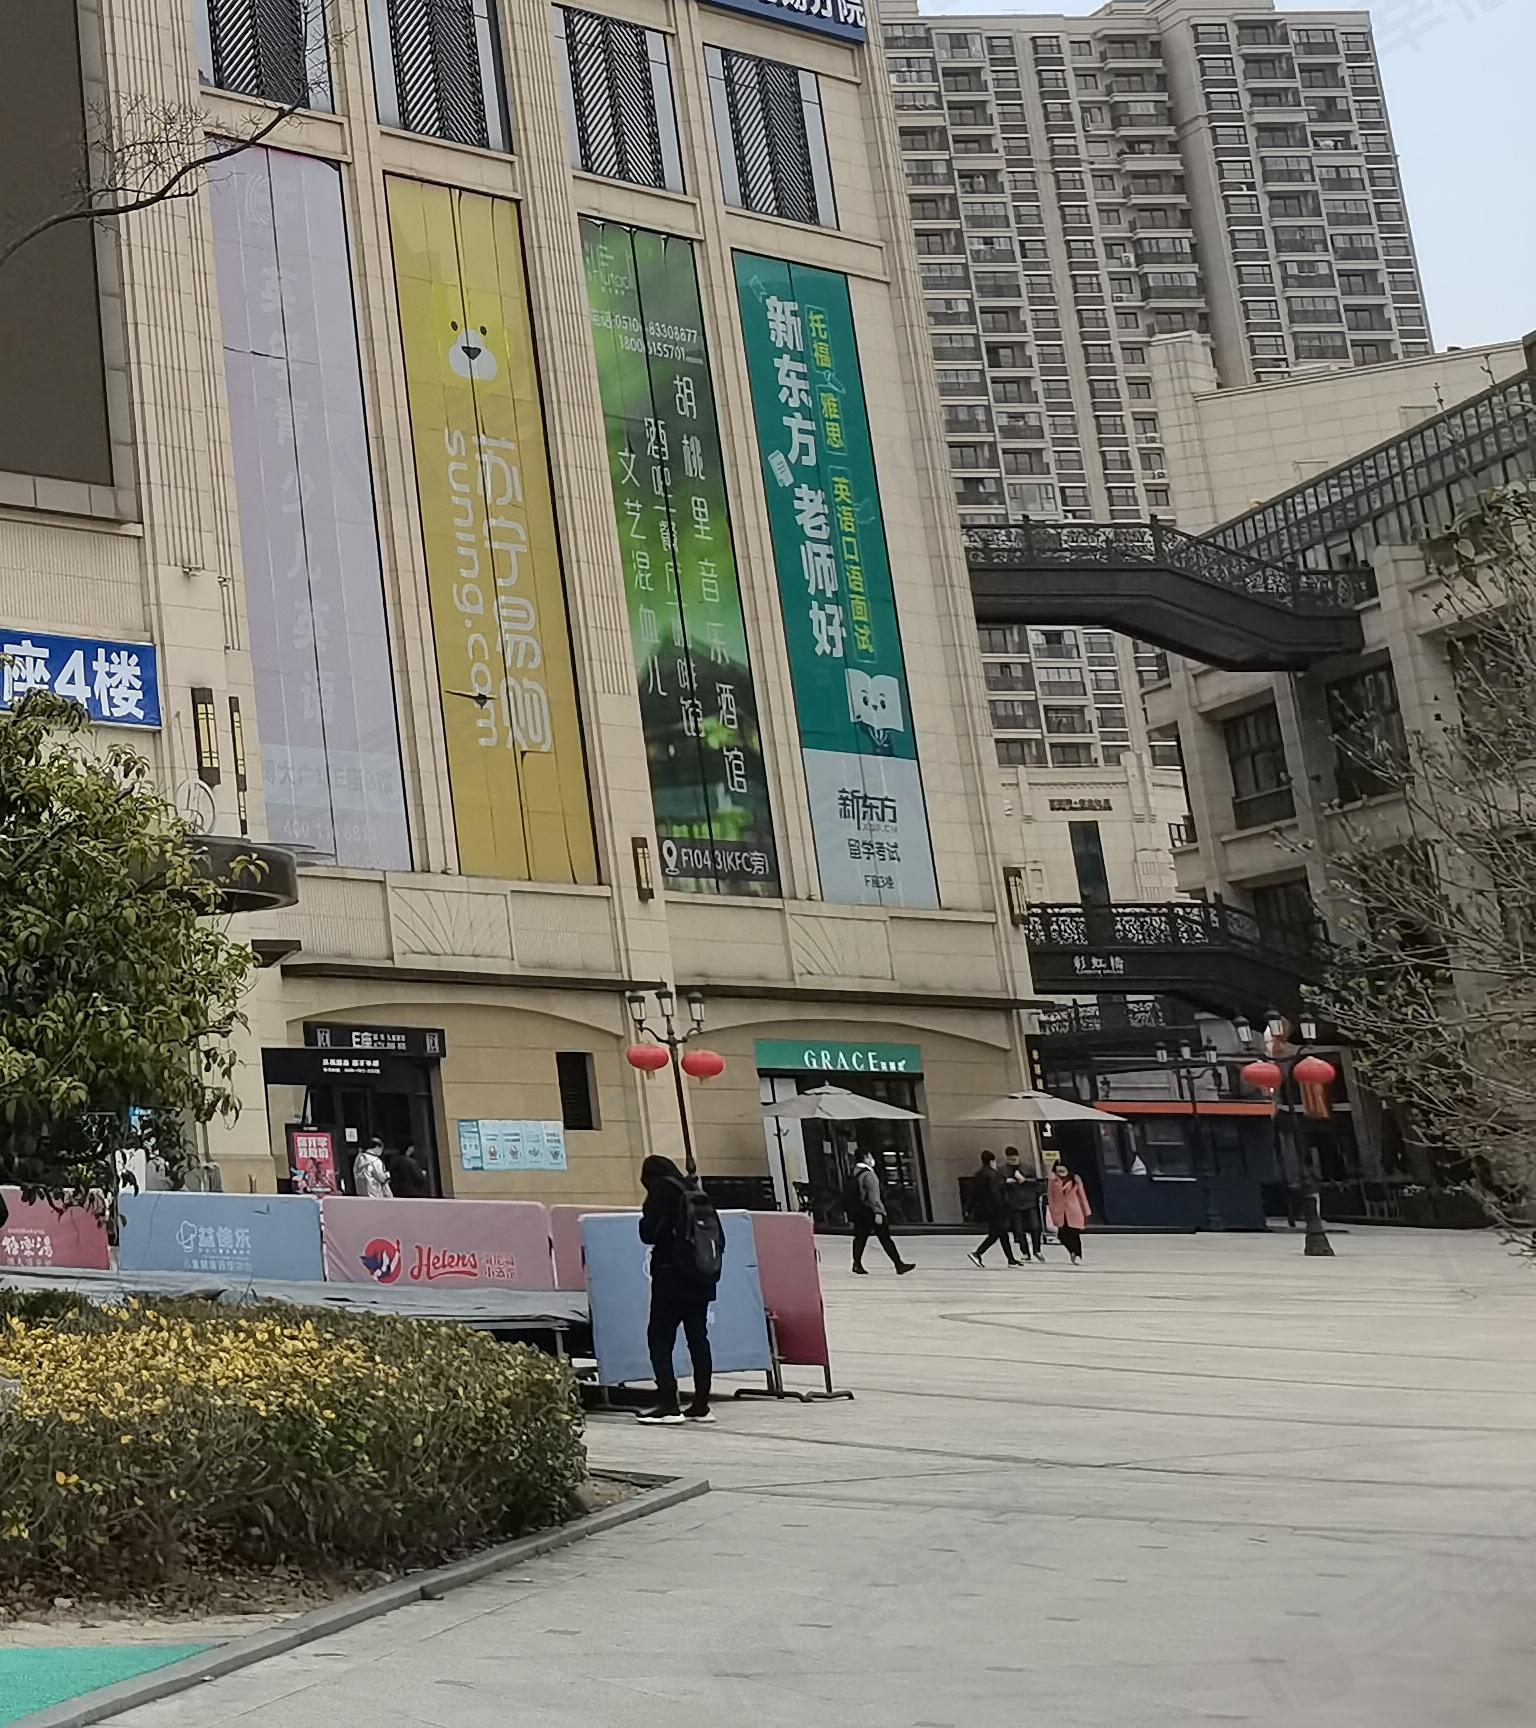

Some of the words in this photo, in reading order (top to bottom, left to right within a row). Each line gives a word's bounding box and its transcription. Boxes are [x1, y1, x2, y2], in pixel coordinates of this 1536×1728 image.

[765, 295, 847, 658] 新东方老师好
[445, 426, 499, 748] suning.com
[473, 430, 554, 753] 苏宁易购
[837, 787, 898, 832] 新东方
[847, 837, 902, 864] 留学考试
[802, 1049, 879, 1072] GRACE
